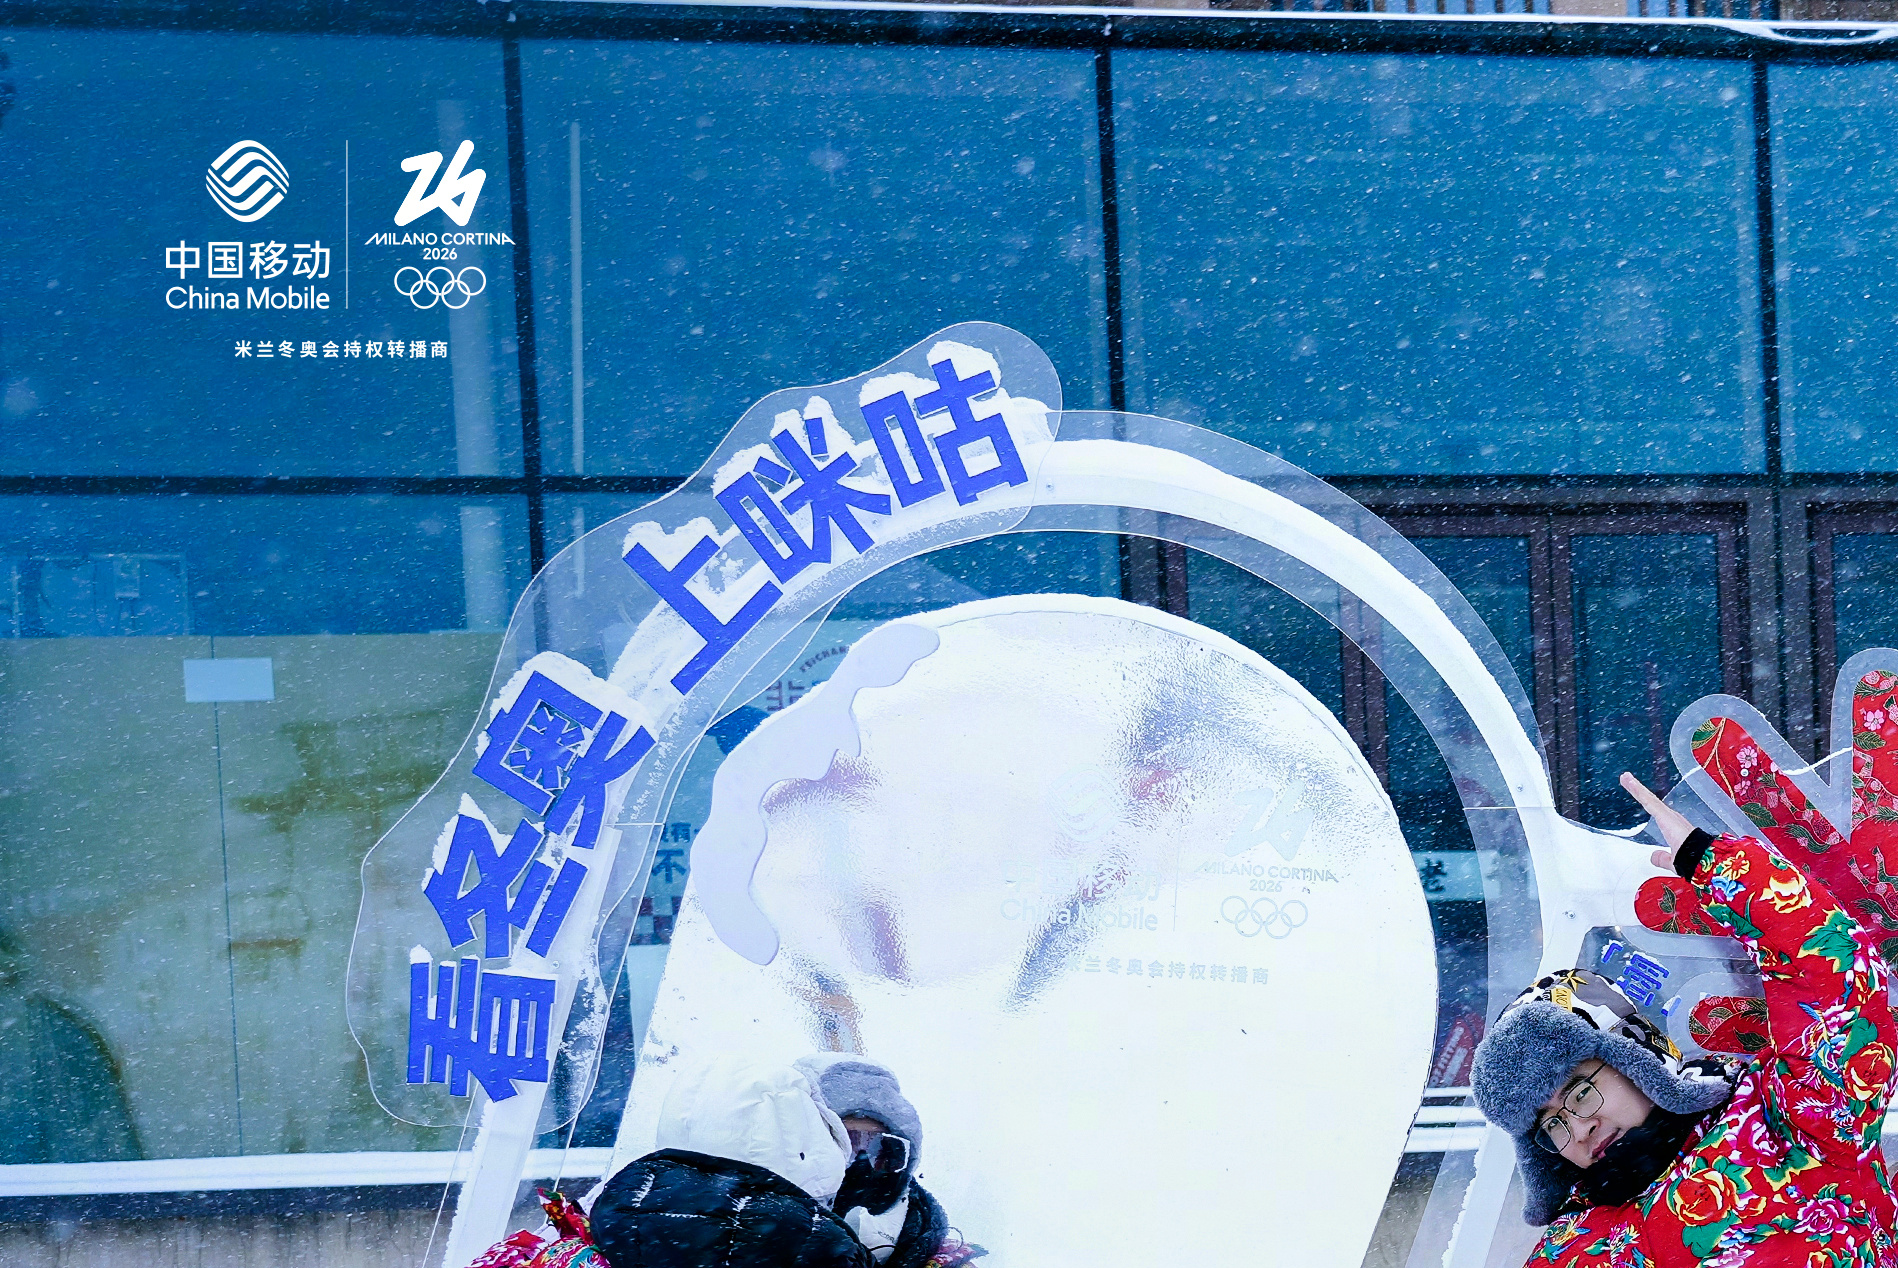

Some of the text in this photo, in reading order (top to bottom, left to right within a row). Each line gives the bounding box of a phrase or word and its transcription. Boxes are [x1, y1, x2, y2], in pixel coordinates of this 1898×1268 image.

[406, 358, 1029, 1104] 看冬奥 上咪咕
[1249, 879, 1284, 894] 2026
